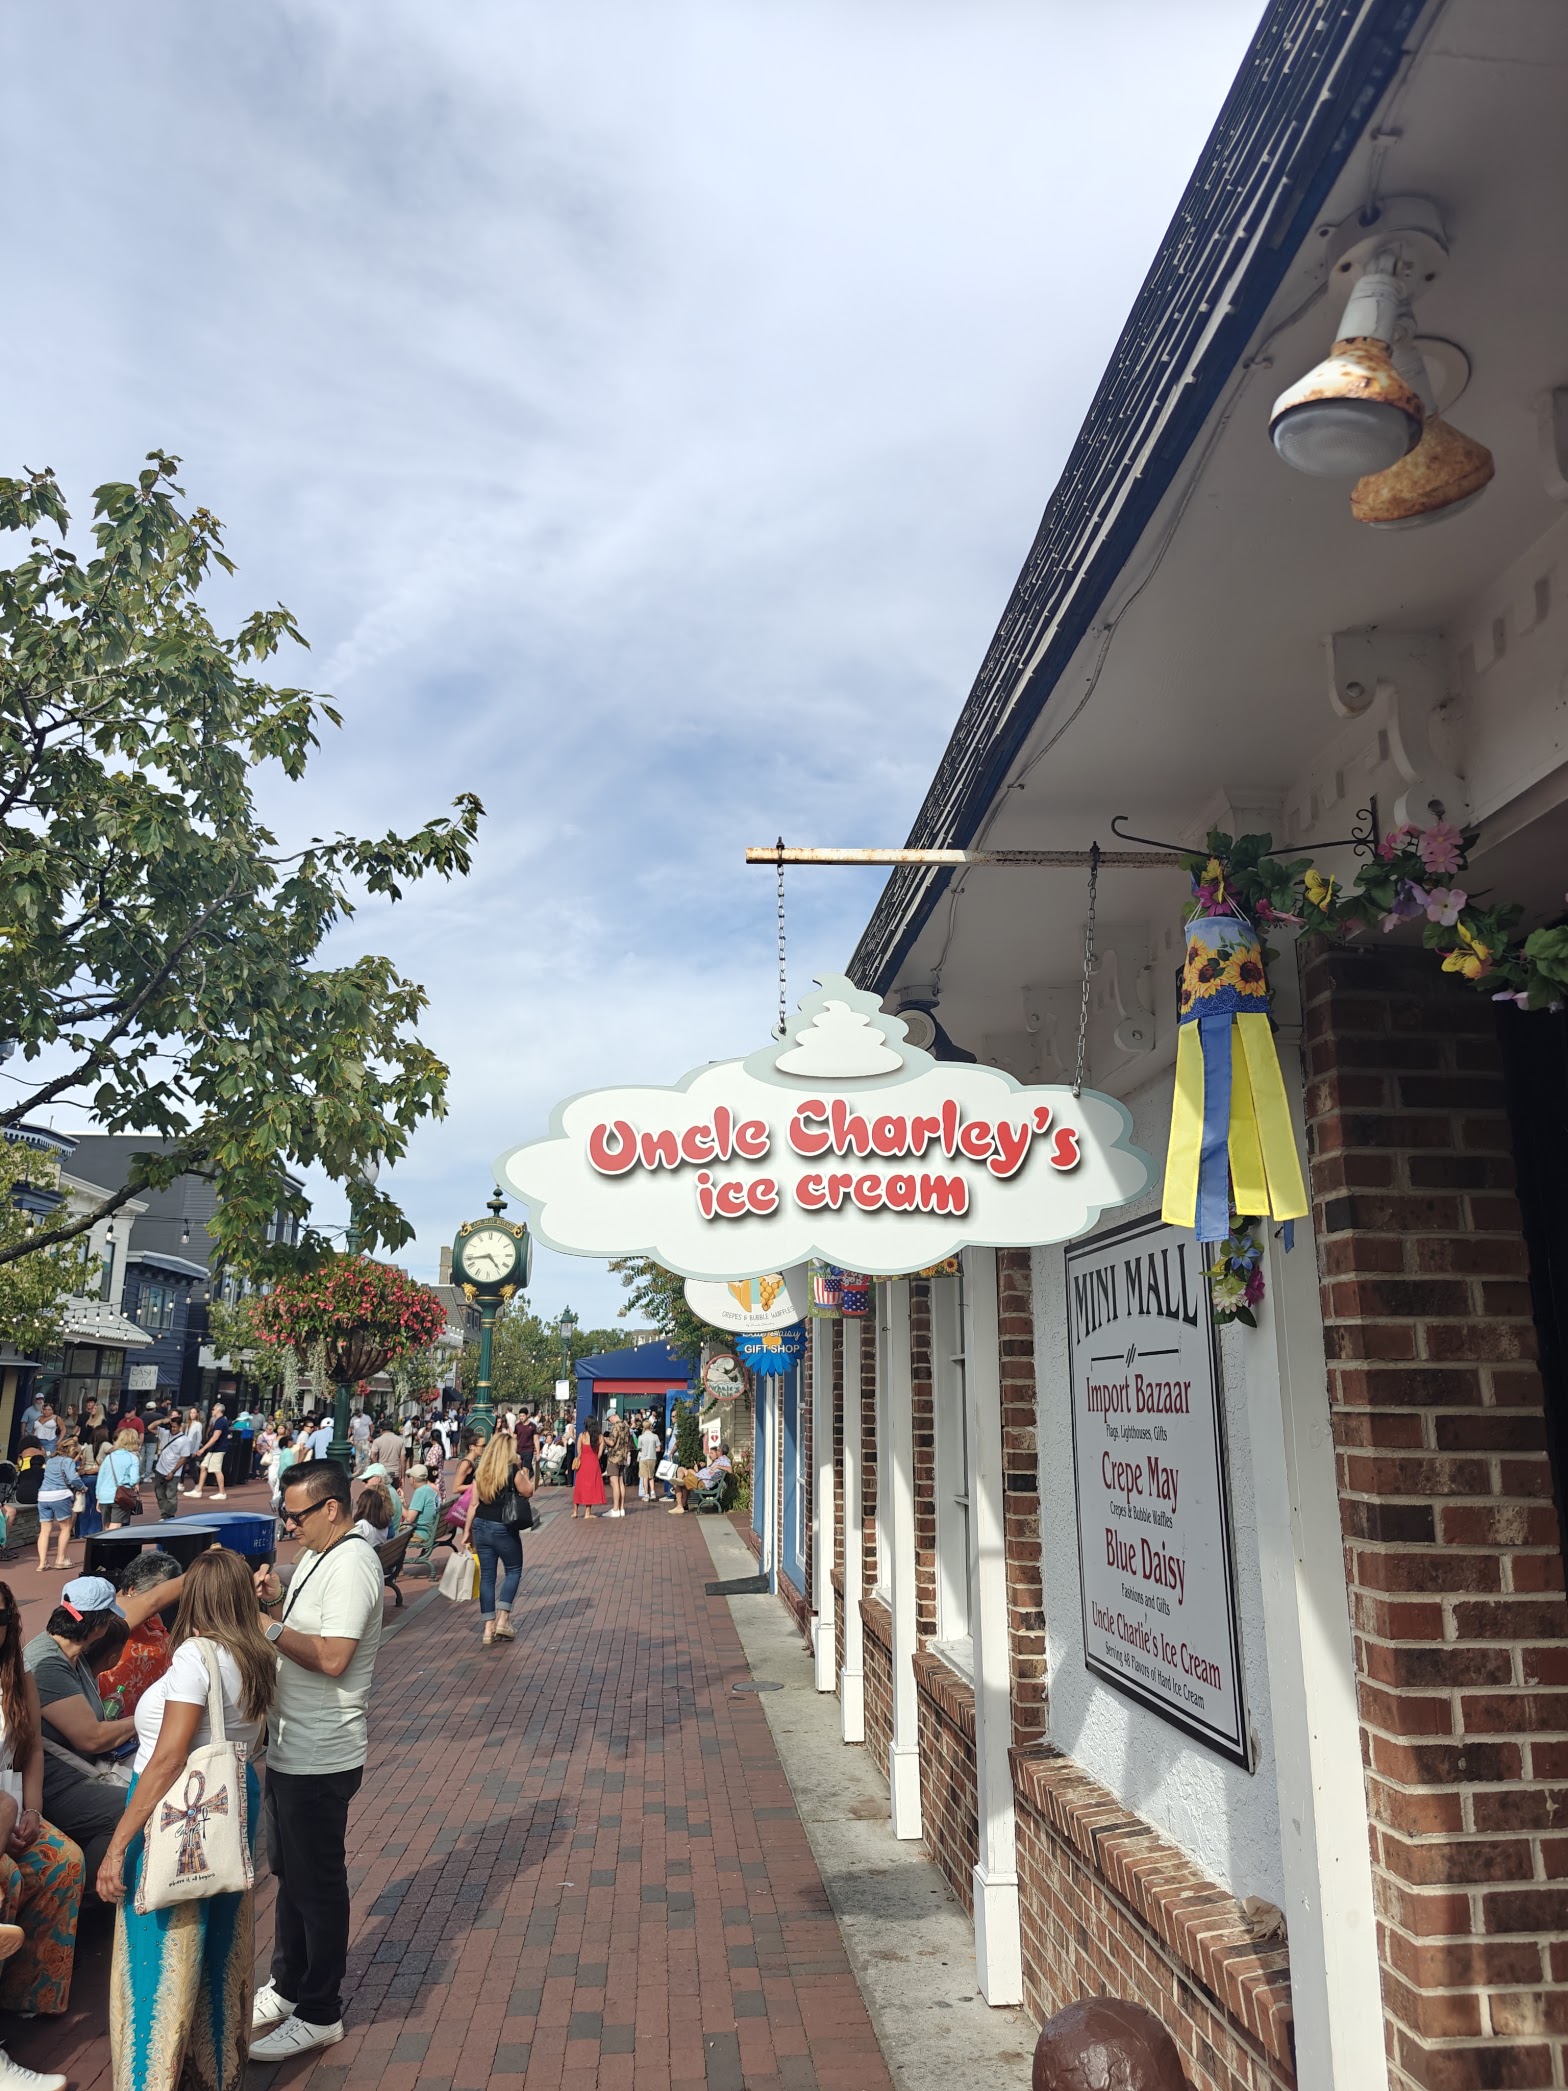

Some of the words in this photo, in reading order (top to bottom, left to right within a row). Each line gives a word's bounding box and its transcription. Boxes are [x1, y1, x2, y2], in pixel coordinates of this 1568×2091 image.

[588, 1105, 769, 1174] Uncle
[787, 1098, 1080, 1177] Charley's
[696, 1171, 778, 1217] ice
[794, 1172, 968, 1214] cream
[722, 1311, 742, 1321] CREPES
[750, 1313, 769, 1321] BUBBLE
[1074, 1264, 1118, 1345] MINI
[1124, 1243, 1198, 1328] MALL
[744, 1344, 768, 1354] GIFT
[771, 1344, 800, 1353] SHOP
[709, 1384, 740, 1393] Whale's
[1086, 1374, 1131, 1423] Import
[1134, 1374, 1191, 1414] Bazaar
[1106, 1424, 1120, 1441] Flags,
[1120, 1425, 1153, 1443] Lighthouses,
[1153, 1425, 1168, 1441] Gifts
[1102, 1450, 1143, 1504] Crepe
[1147, 1456, 1179, 1514] May
[1110, 1501, 1126, 1519] Crepes
[1127, 1504, 1132, 1519] &
[1133, 1505, 1152, 1523] Bubble
[1152, 1510, 1173, 1529] Waffles
[1105, 1527, 1137, 1576] Blue
[1140, 1537, 1186, 1606] Daisy
[1121, 1583, 1144, 1605] Fashions
[1145, 1595, 1155, 1609] and
[1156, 1596, 1171, 1616] Gifts
[1091, 1601, 1115, 1635] Uncle
[1117, 1612, 1159, 1658] Charlie's
[1160, 1633, 1178, 1668] Ice
[1181, 1642, 1222, 1691] Cream
[1105, 1641, 1124, 1667] Serving
[1131, 1655, 1150, 1679] Flavors
[1151, 1666, 1157, 1682] of
[1157, 1667, 1172, 1691] Hard
[1172, 1678, 1182, 1697] Ice
[1183, 1683, 1205, 1710] Cream
[168, 1878, 185, 1888] where
